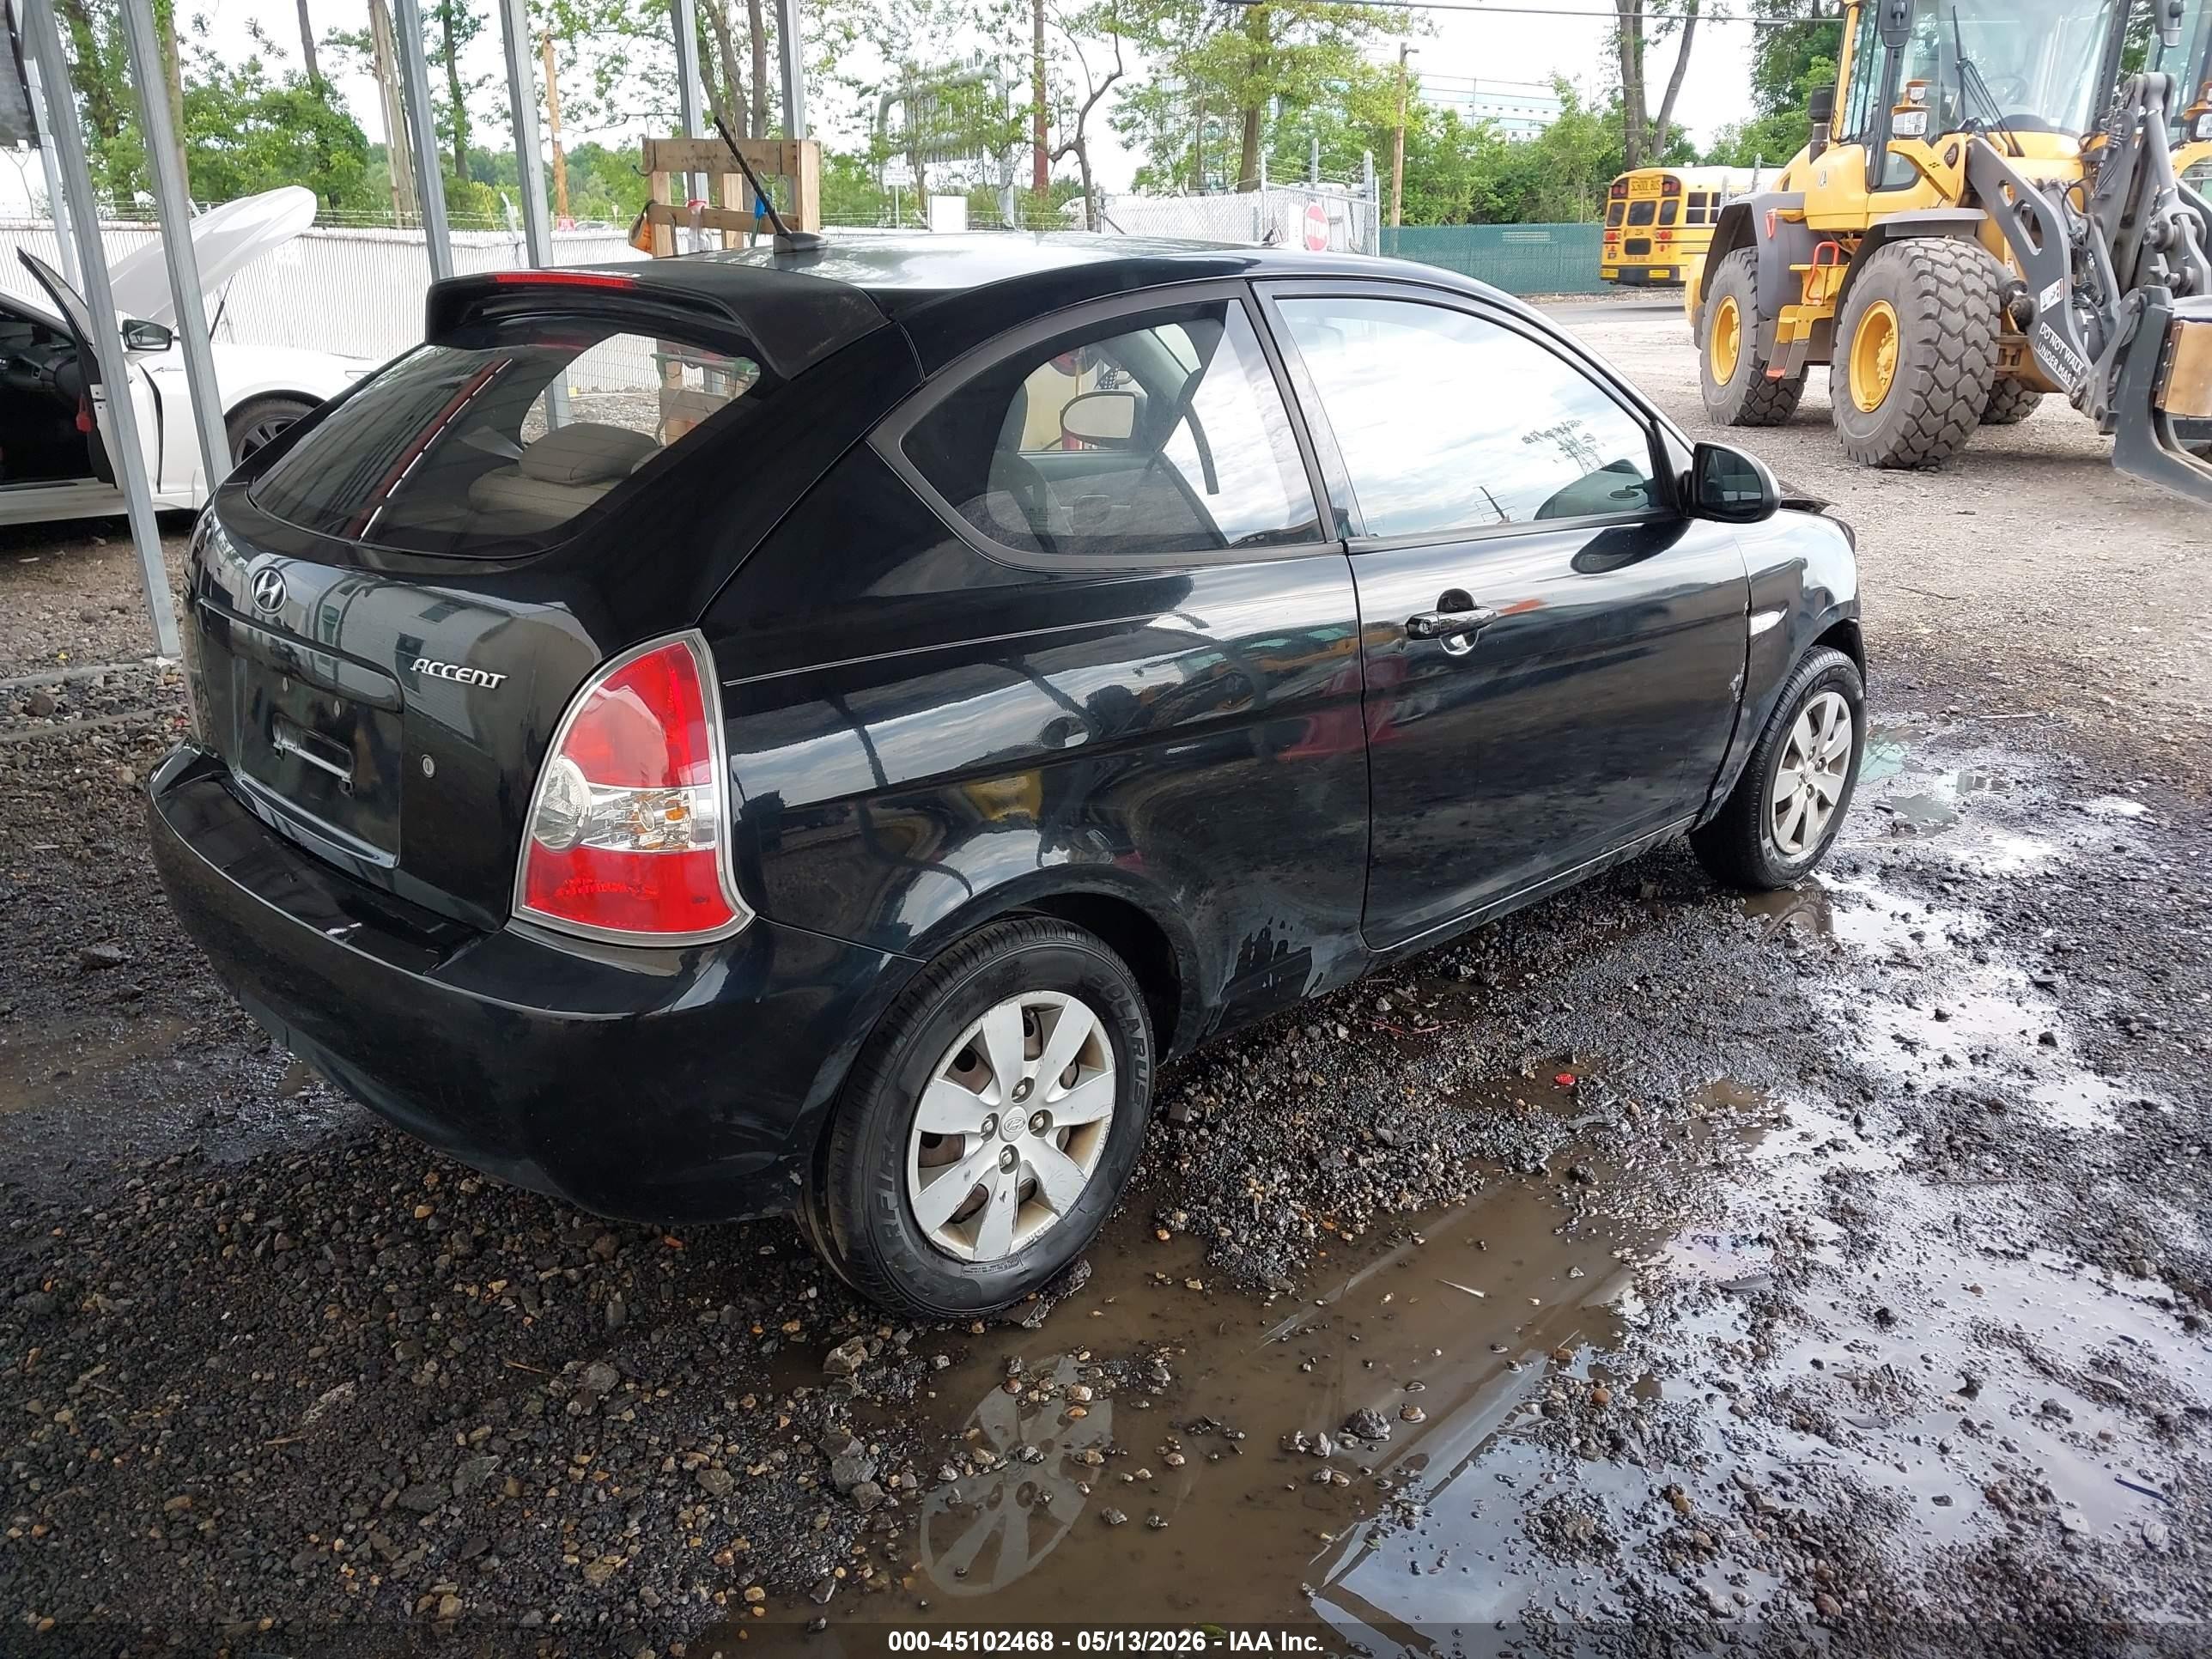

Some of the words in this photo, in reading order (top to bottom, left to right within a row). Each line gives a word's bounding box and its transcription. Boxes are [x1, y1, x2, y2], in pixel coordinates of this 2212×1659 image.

[1631, 180, 1650, 191] SCHOOL
[1650, 179, 1661, 191] BUS
[1306, 216, 1327, 240] STOP
[2038, 341, 2059, 370] UNDER
[2039, 324, 2051, 339] DO
[2050, 334, 2067, 355] NOT
[2064, 348, 2083, 375] WALK
[410, 658, 508, 689] ACCENT
